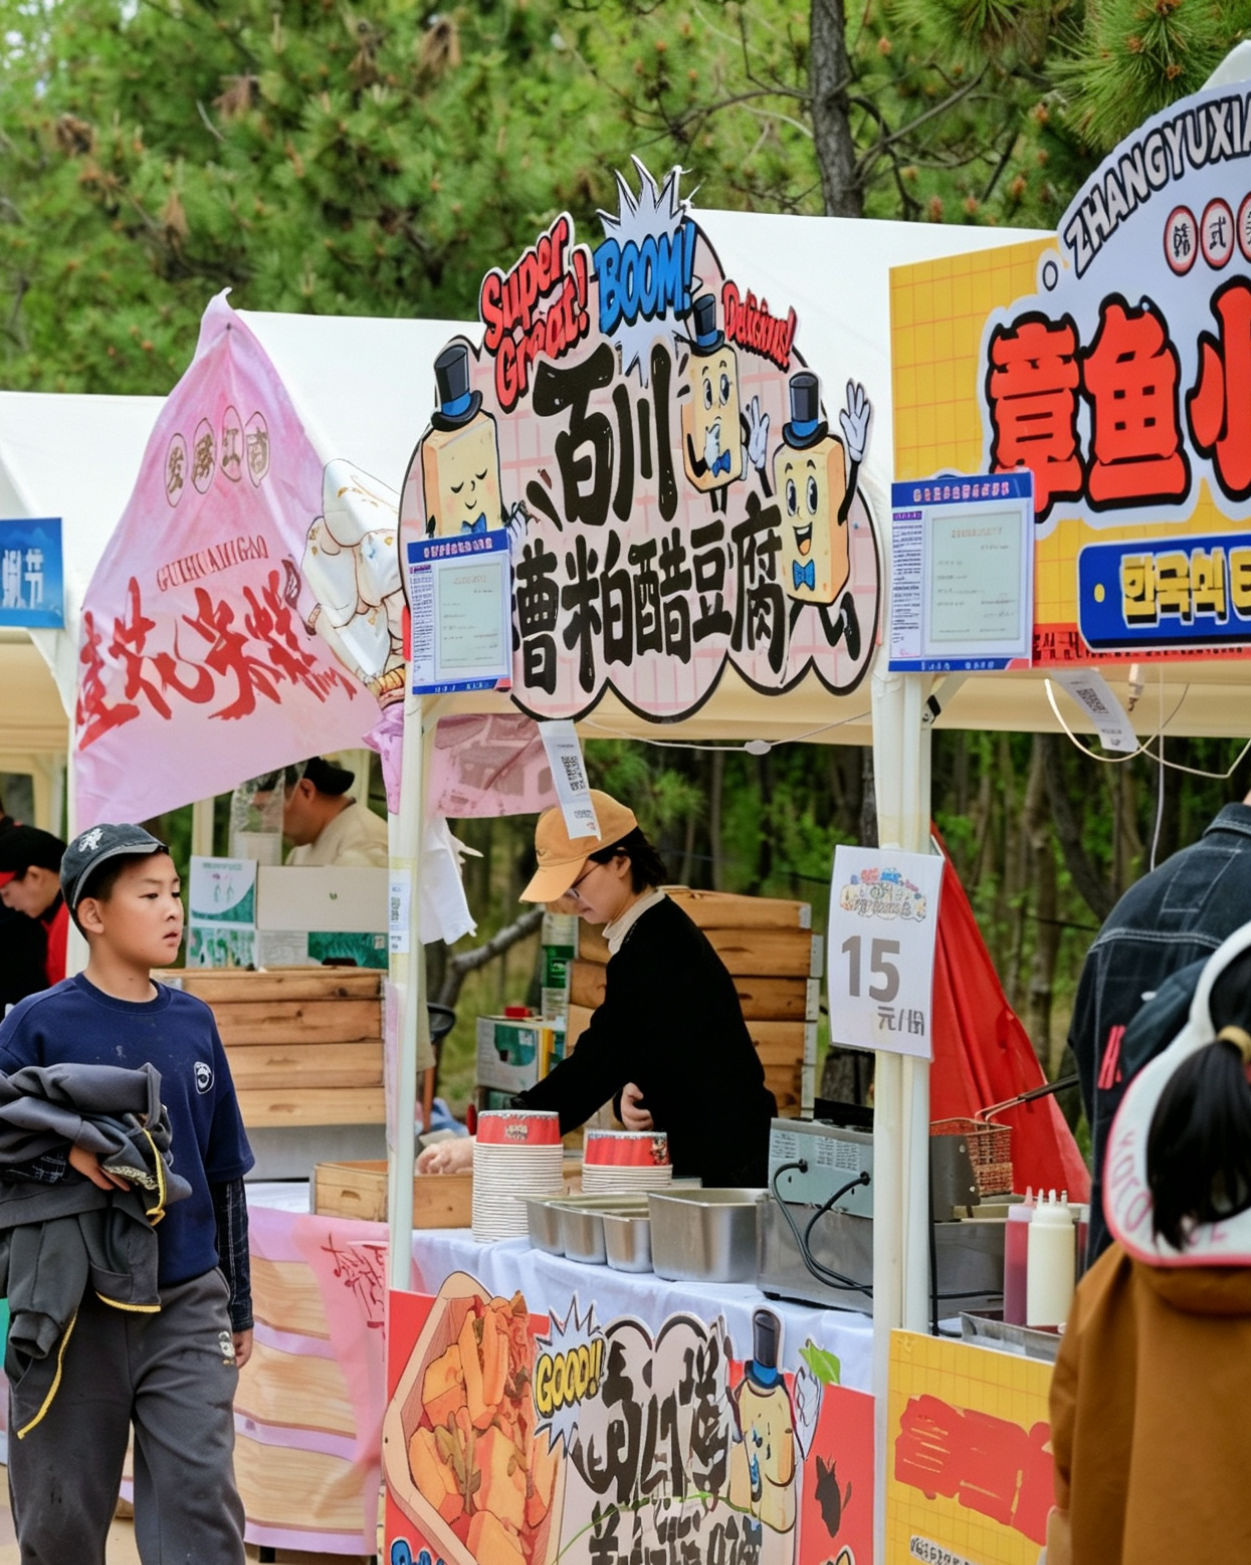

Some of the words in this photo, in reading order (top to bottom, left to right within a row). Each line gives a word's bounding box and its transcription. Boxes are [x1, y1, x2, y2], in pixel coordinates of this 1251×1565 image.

[1063, 91, 1251, 280] ZHANGYUXI
[481, 214, 570, 352] Super
[593, 217, 699, 337] BOOM!
[532, 341, 680, 527] 百川
[842, 935, 901, 1002] 15
[878, 1006, 925, 1036] 元/份
[535, 1337, 606, 1419] GOOD!!
